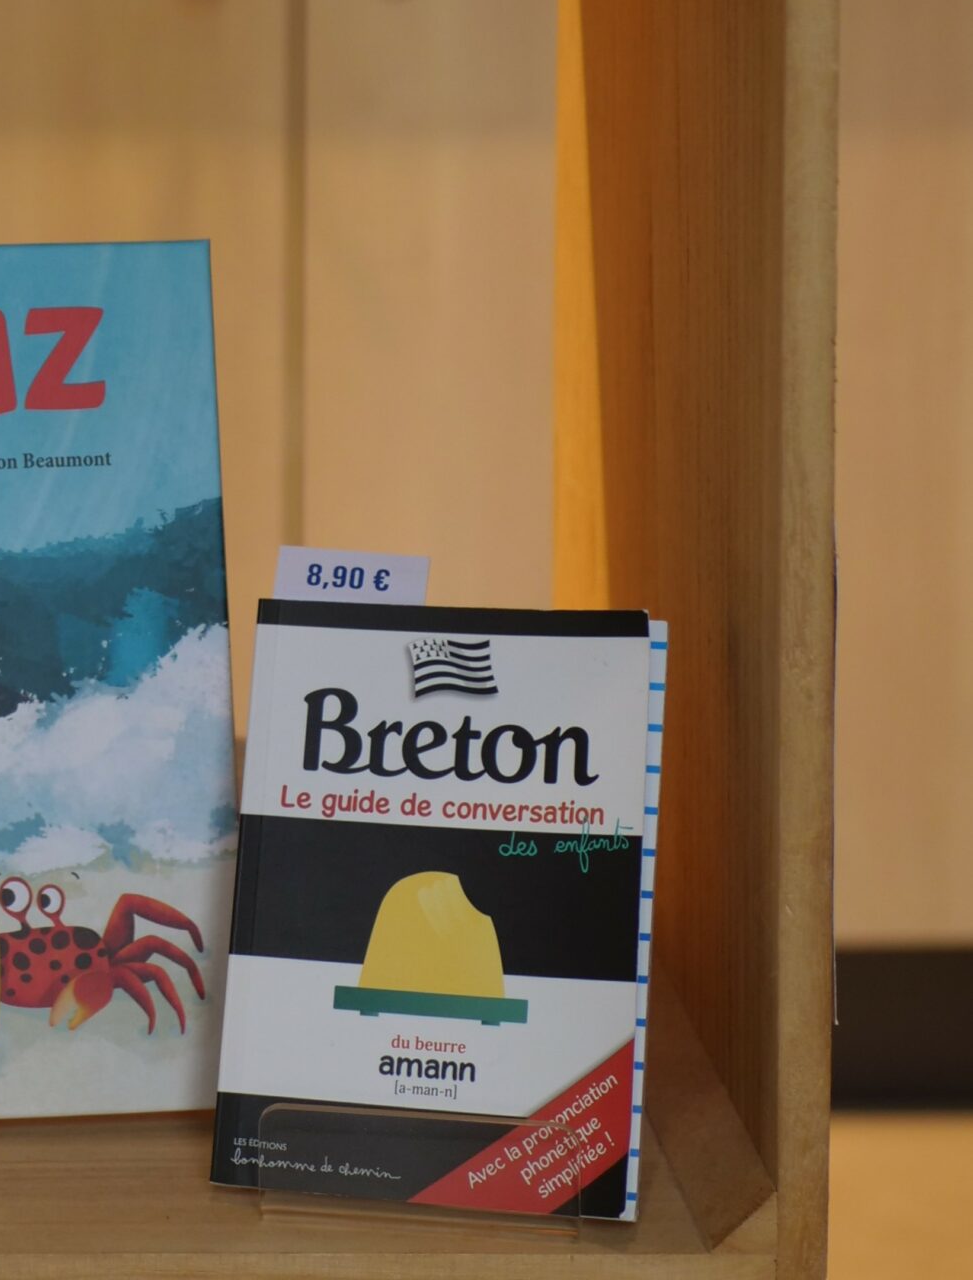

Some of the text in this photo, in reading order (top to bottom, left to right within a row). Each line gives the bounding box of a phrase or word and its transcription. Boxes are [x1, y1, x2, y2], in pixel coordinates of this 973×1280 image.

[23, 451, 112, 469] Beaumont
[306, 563, 391, 592] 8,90 €
[302, 687, 600, 787] Breton
[280, 784, 605, 826] Le guide de conversation
[498, 831, 538, 857] des
[391, 1034, 467, 1054] du beurre
[378, 1055, 476, 1083] amann
[394, 1079, 458, 1100] [a-man-n]
[233, 1137, 247, 1146] LES
[467, 1074, 619, 1189] Avec la prononciation
[230, 1147, 402, 1180] bonhomme de chemin
[520, 1117, 602, 1185] phonétique
